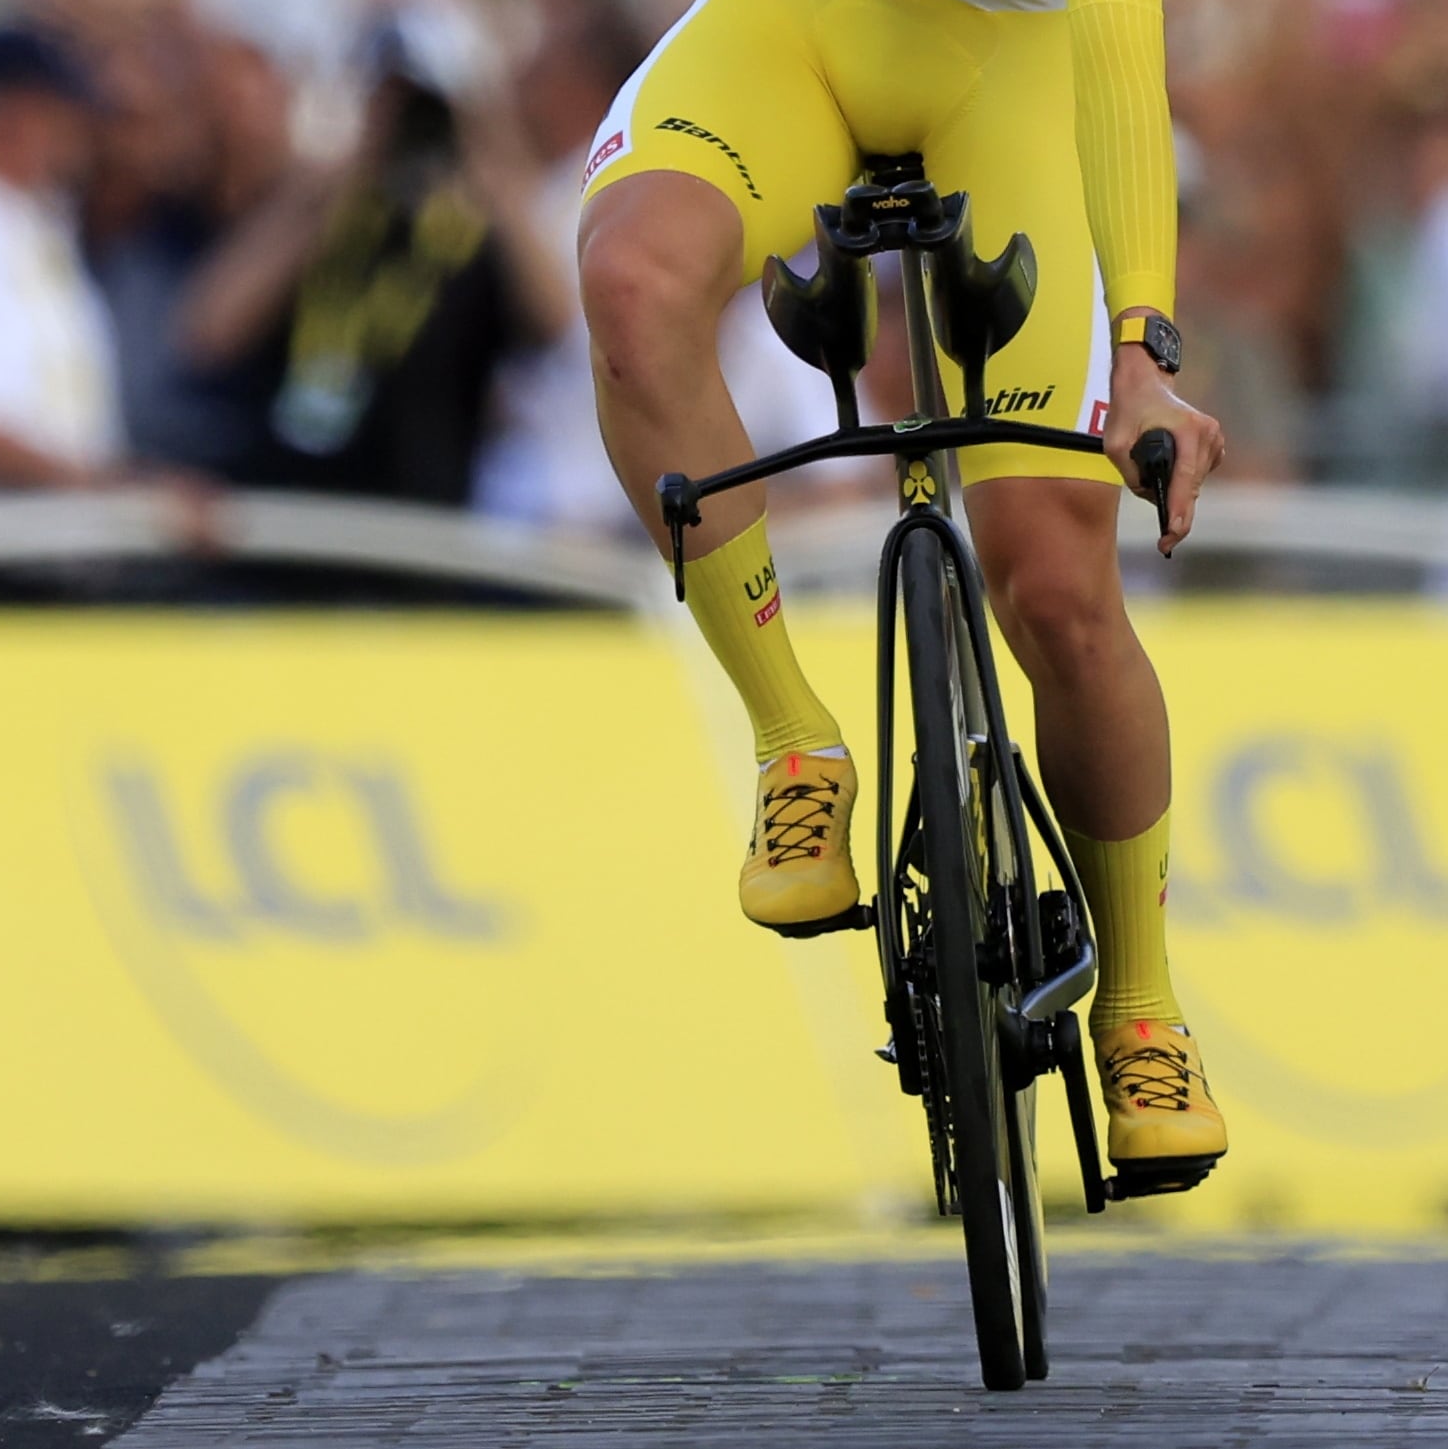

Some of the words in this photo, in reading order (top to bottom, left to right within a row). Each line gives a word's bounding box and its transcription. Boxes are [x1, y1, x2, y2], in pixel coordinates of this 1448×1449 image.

[653, 116, 764, 202] Santini
[985, 385, 1056, 417] ntini
[97, 737, 517, 947] LCL
